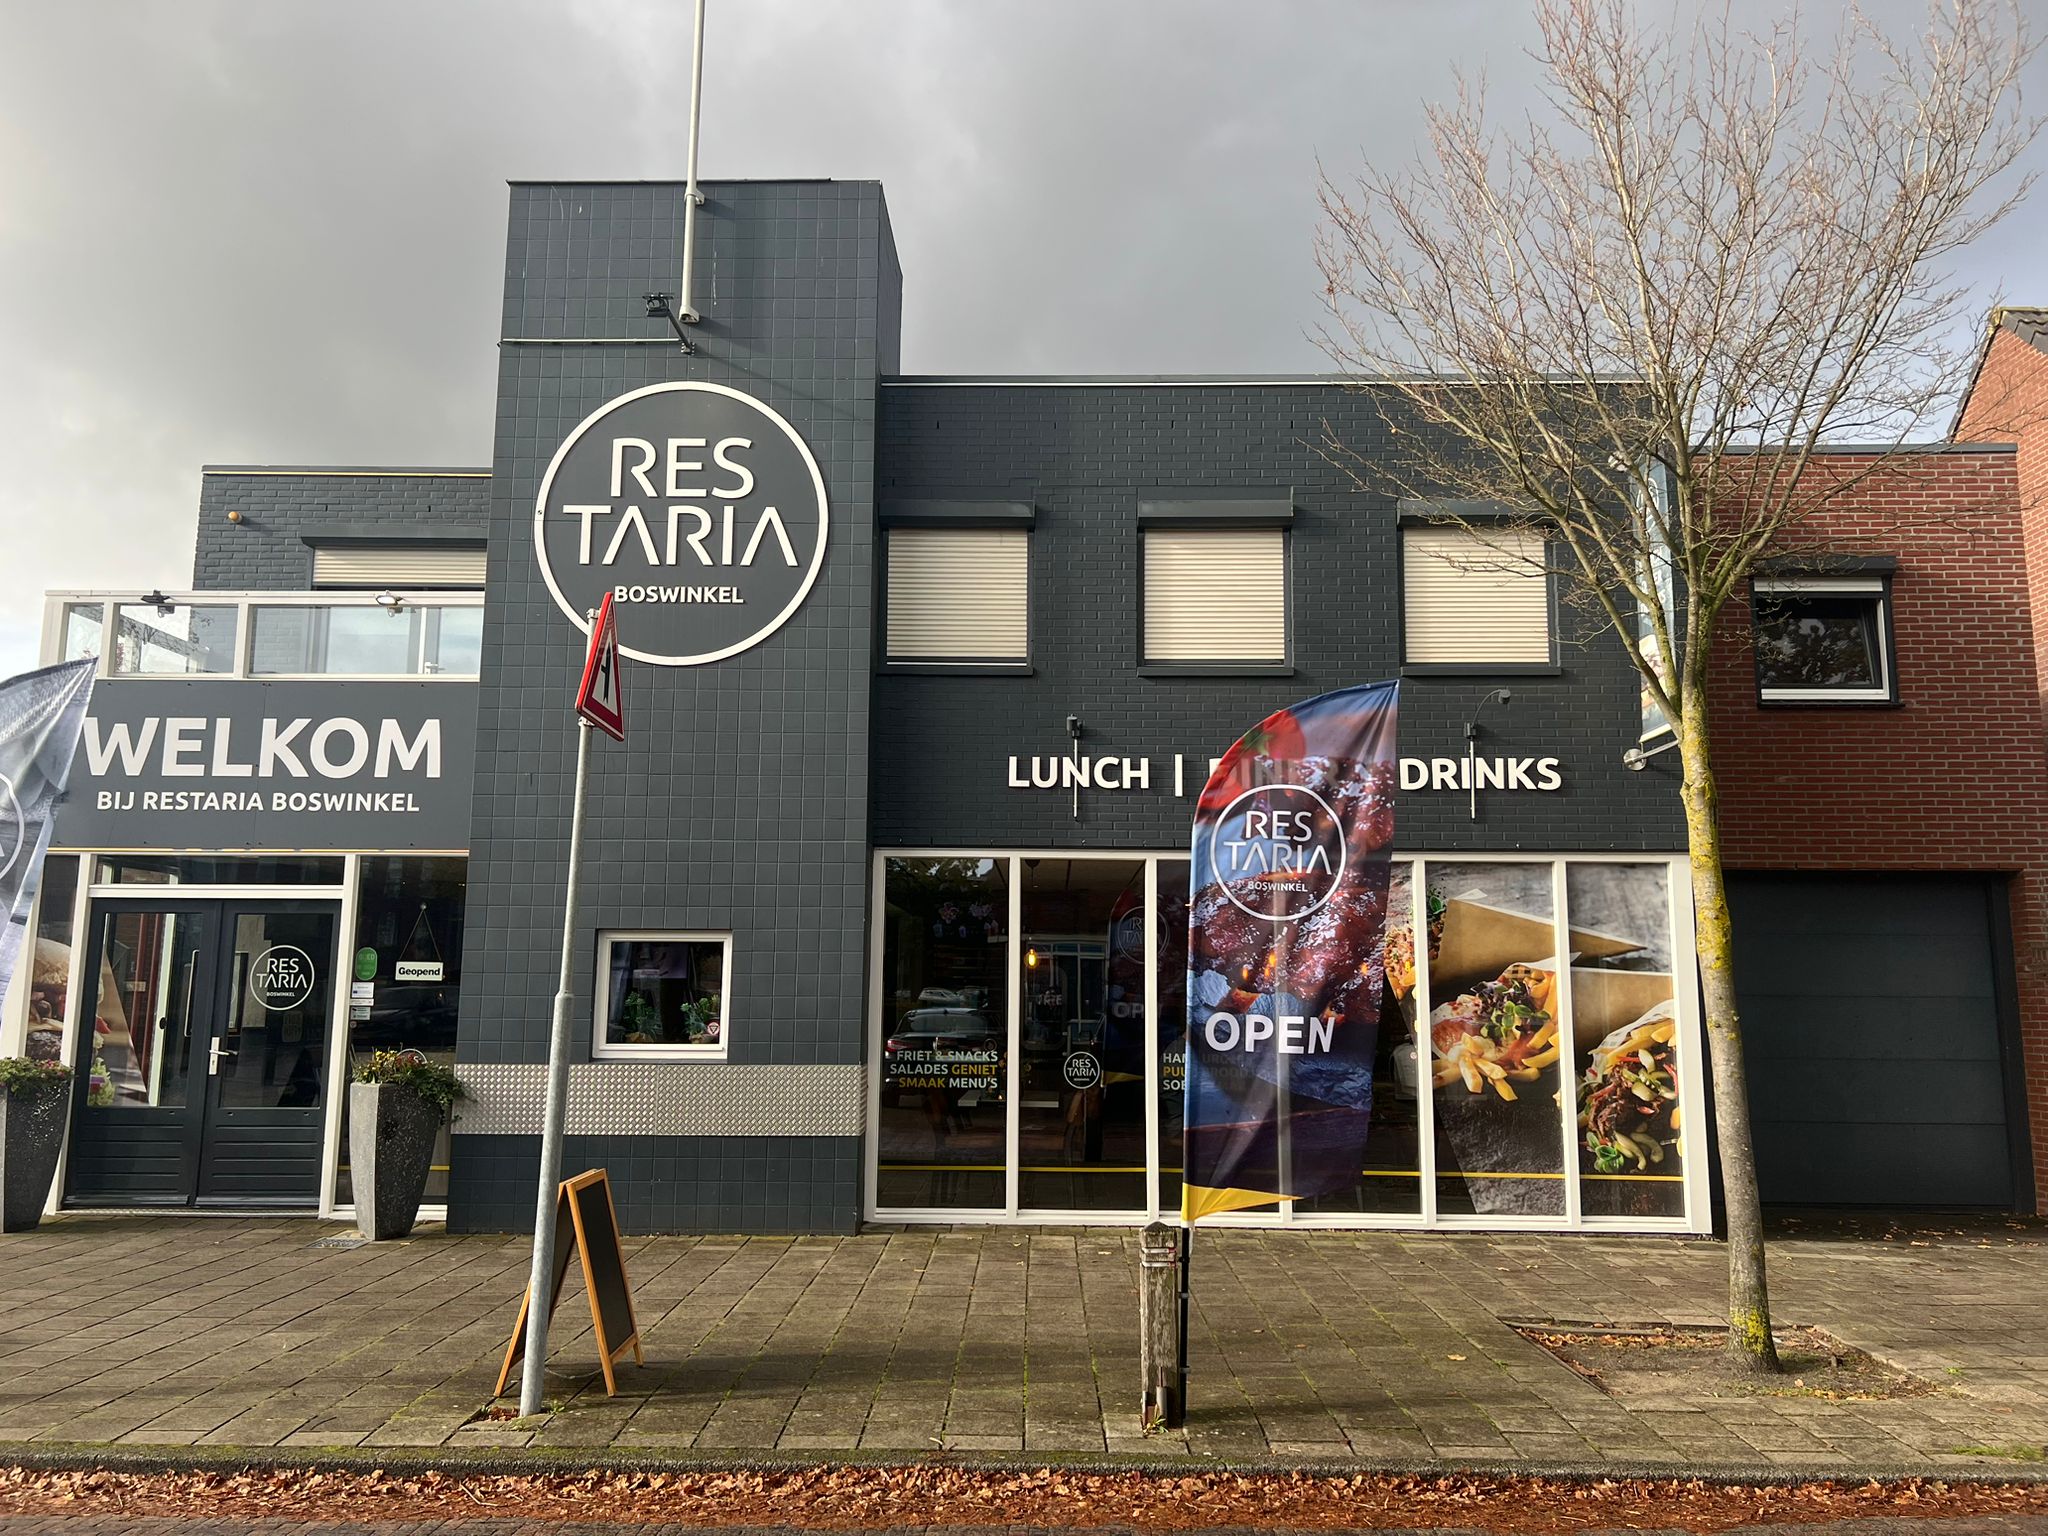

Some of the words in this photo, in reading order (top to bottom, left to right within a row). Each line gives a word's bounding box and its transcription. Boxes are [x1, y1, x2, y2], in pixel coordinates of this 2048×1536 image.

[610, 437, 755, 499] RES
[562, 505, 798, 567] TARIA
[614, 585, 744, 604] BOSWINKEL
[84, 716, 442, 779] WELKOM
[1007, 754, 1150, 790] LUNCH
[1400, 756, 1563, 791] DRINKS
[96, 790, 135, 811] BIJ
[143, 791, 265, 811] RESTARIA
[272, 792, 420, 813] BOSWINKEL
[1245, 810, 1312, 842] RES
[1223, 841, 1332, 875] TARIA
[1248, 881, 1308, 892] BOSWINKEL
[266, 958, 300, 973] RES
[398, 966, 441, 978] Geopend
[256, 973, 308, 989] TARIA
[1205, 1011, 1335, 1055] OPEN
[896, 1050, 931, 1061] FRIET
[948, 1050, 999, 1062] SNACKS
[1072, 1058, 1091, 1068] RES
[890, 1063, 949, 1075] SALADES
[952, 1063, 998, 1075] GENIET
[1066, 1067, 1097, 1077] TARIA
[898, 1077, 946, 1088] SMAAK
[948, 1076, 999, 1089] MENU'S
